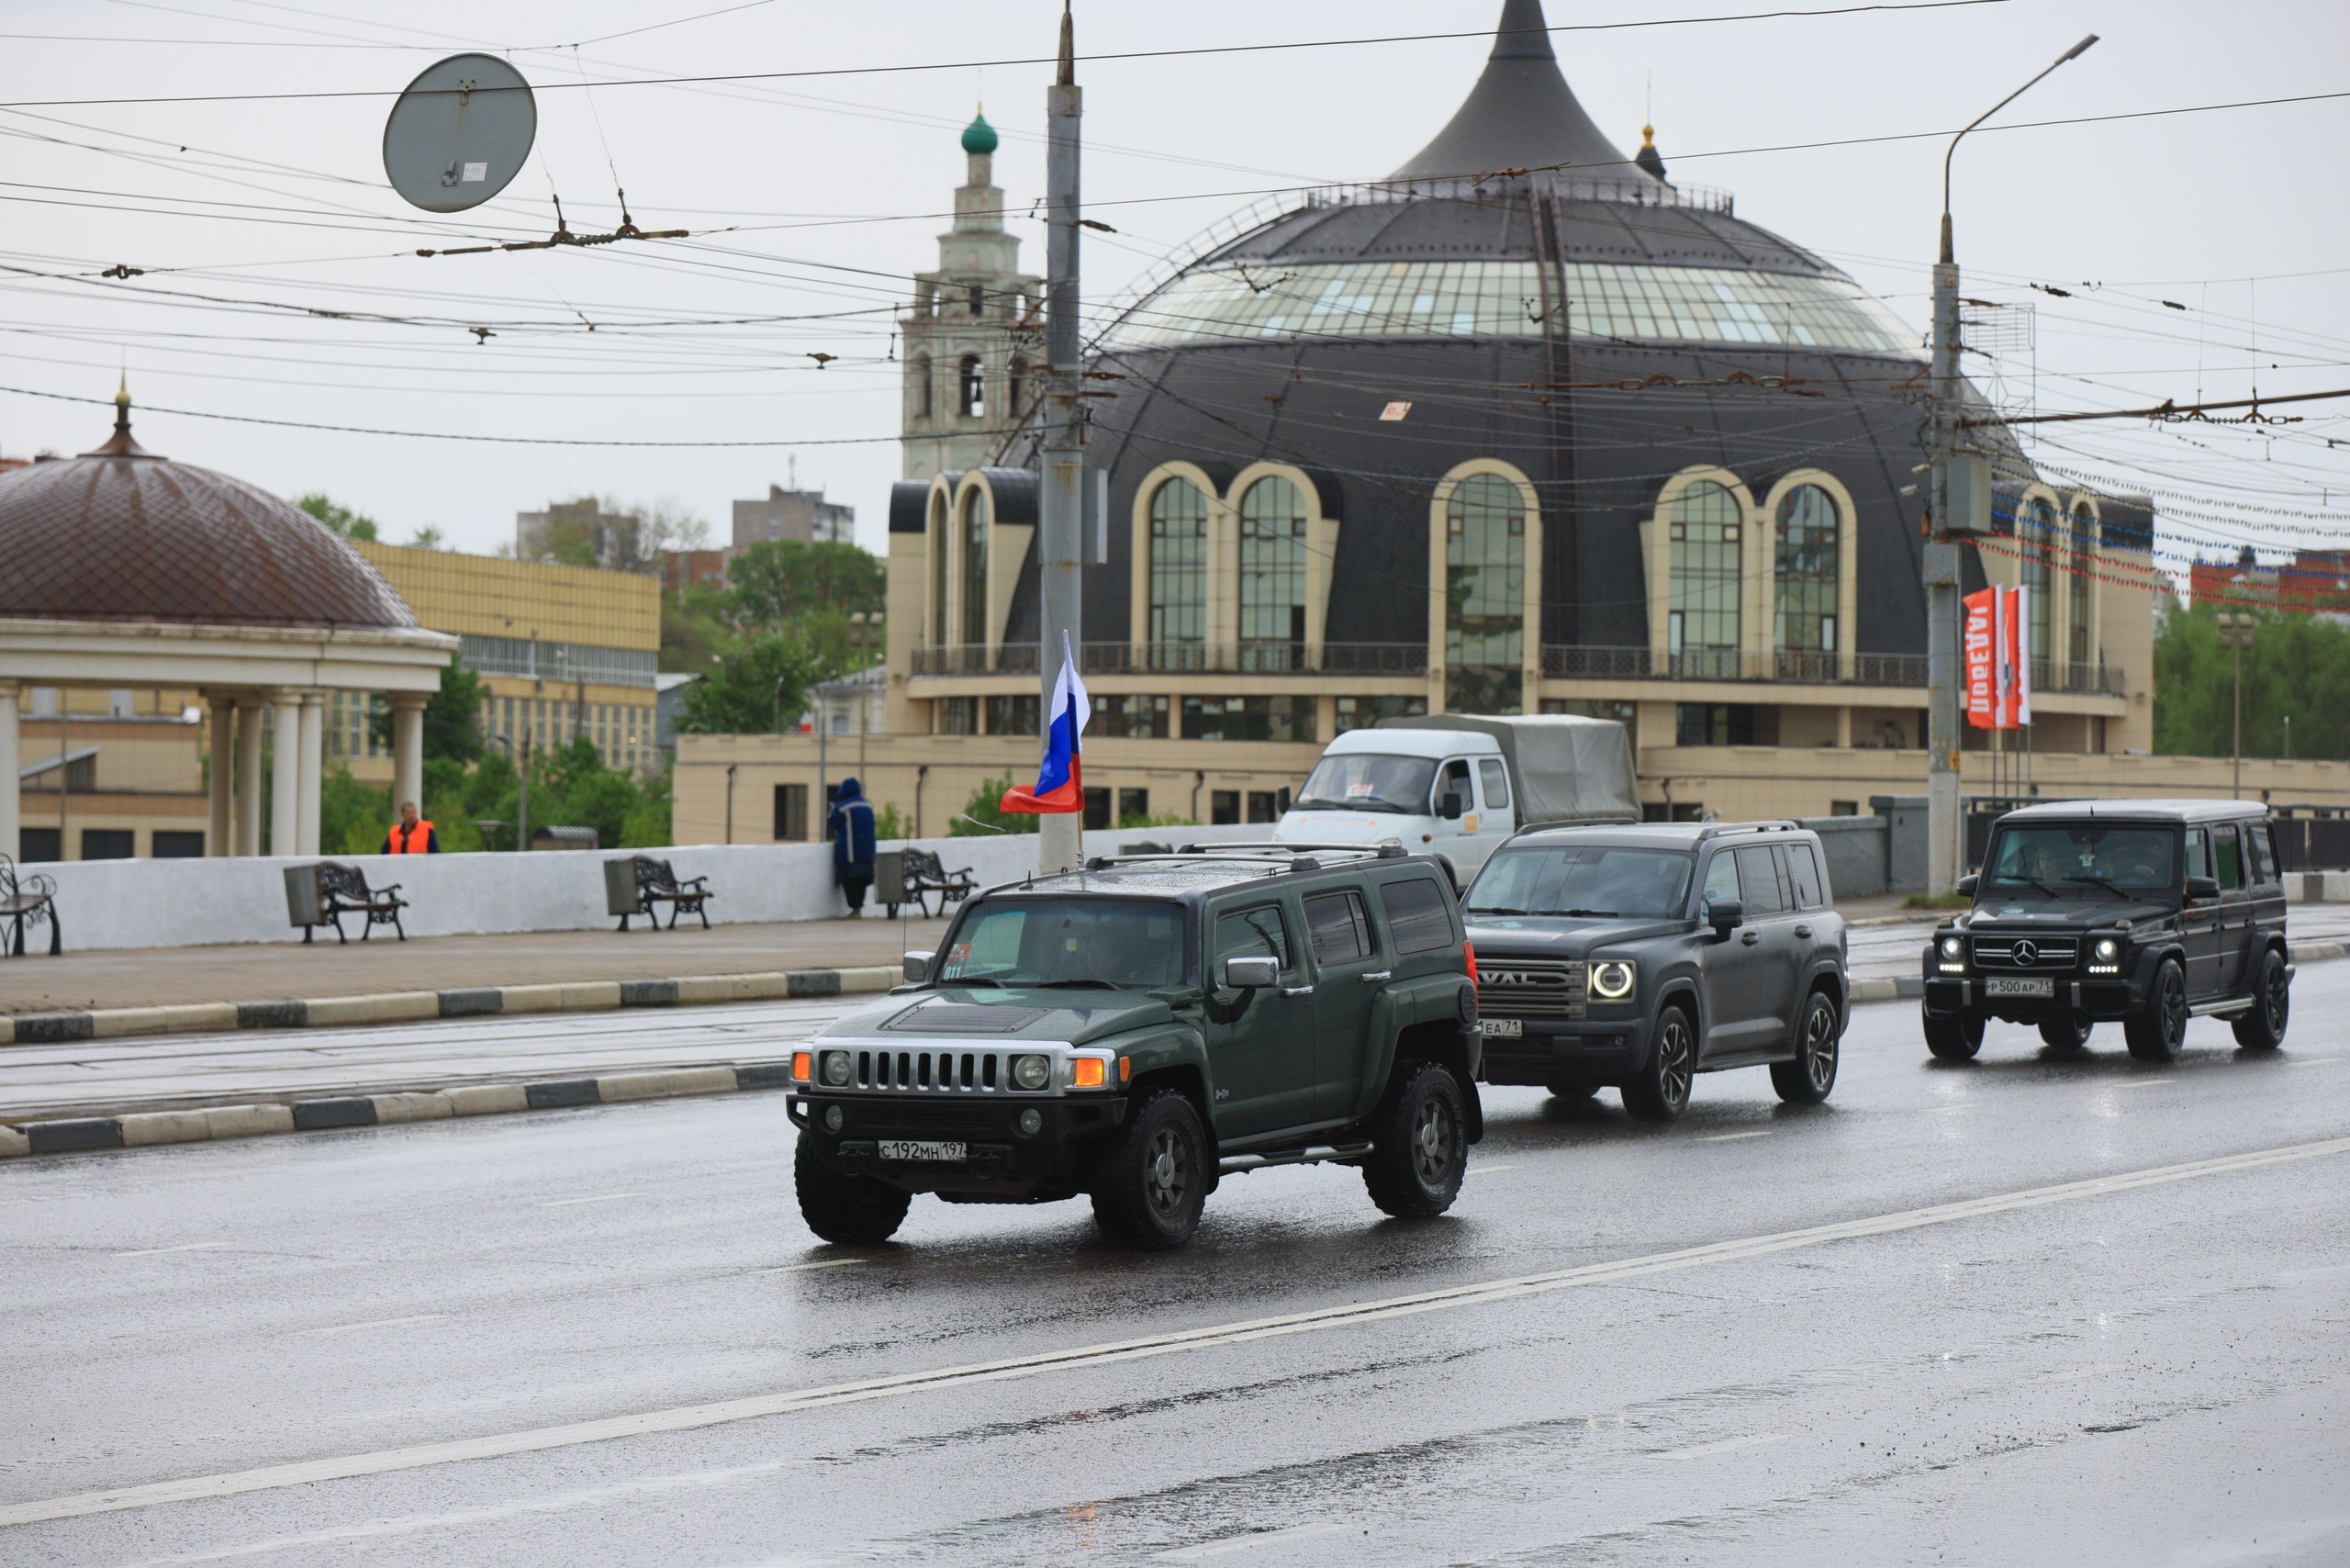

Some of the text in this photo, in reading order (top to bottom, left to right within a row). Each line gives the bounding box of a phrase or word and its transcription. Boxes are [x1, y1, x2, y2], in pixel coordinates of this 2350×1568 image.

[2039, 980, 2051, 991] 71
[1505, 1020, 1518, 1031] 71
[881, 1141, 964, 1159] С192МН 197
